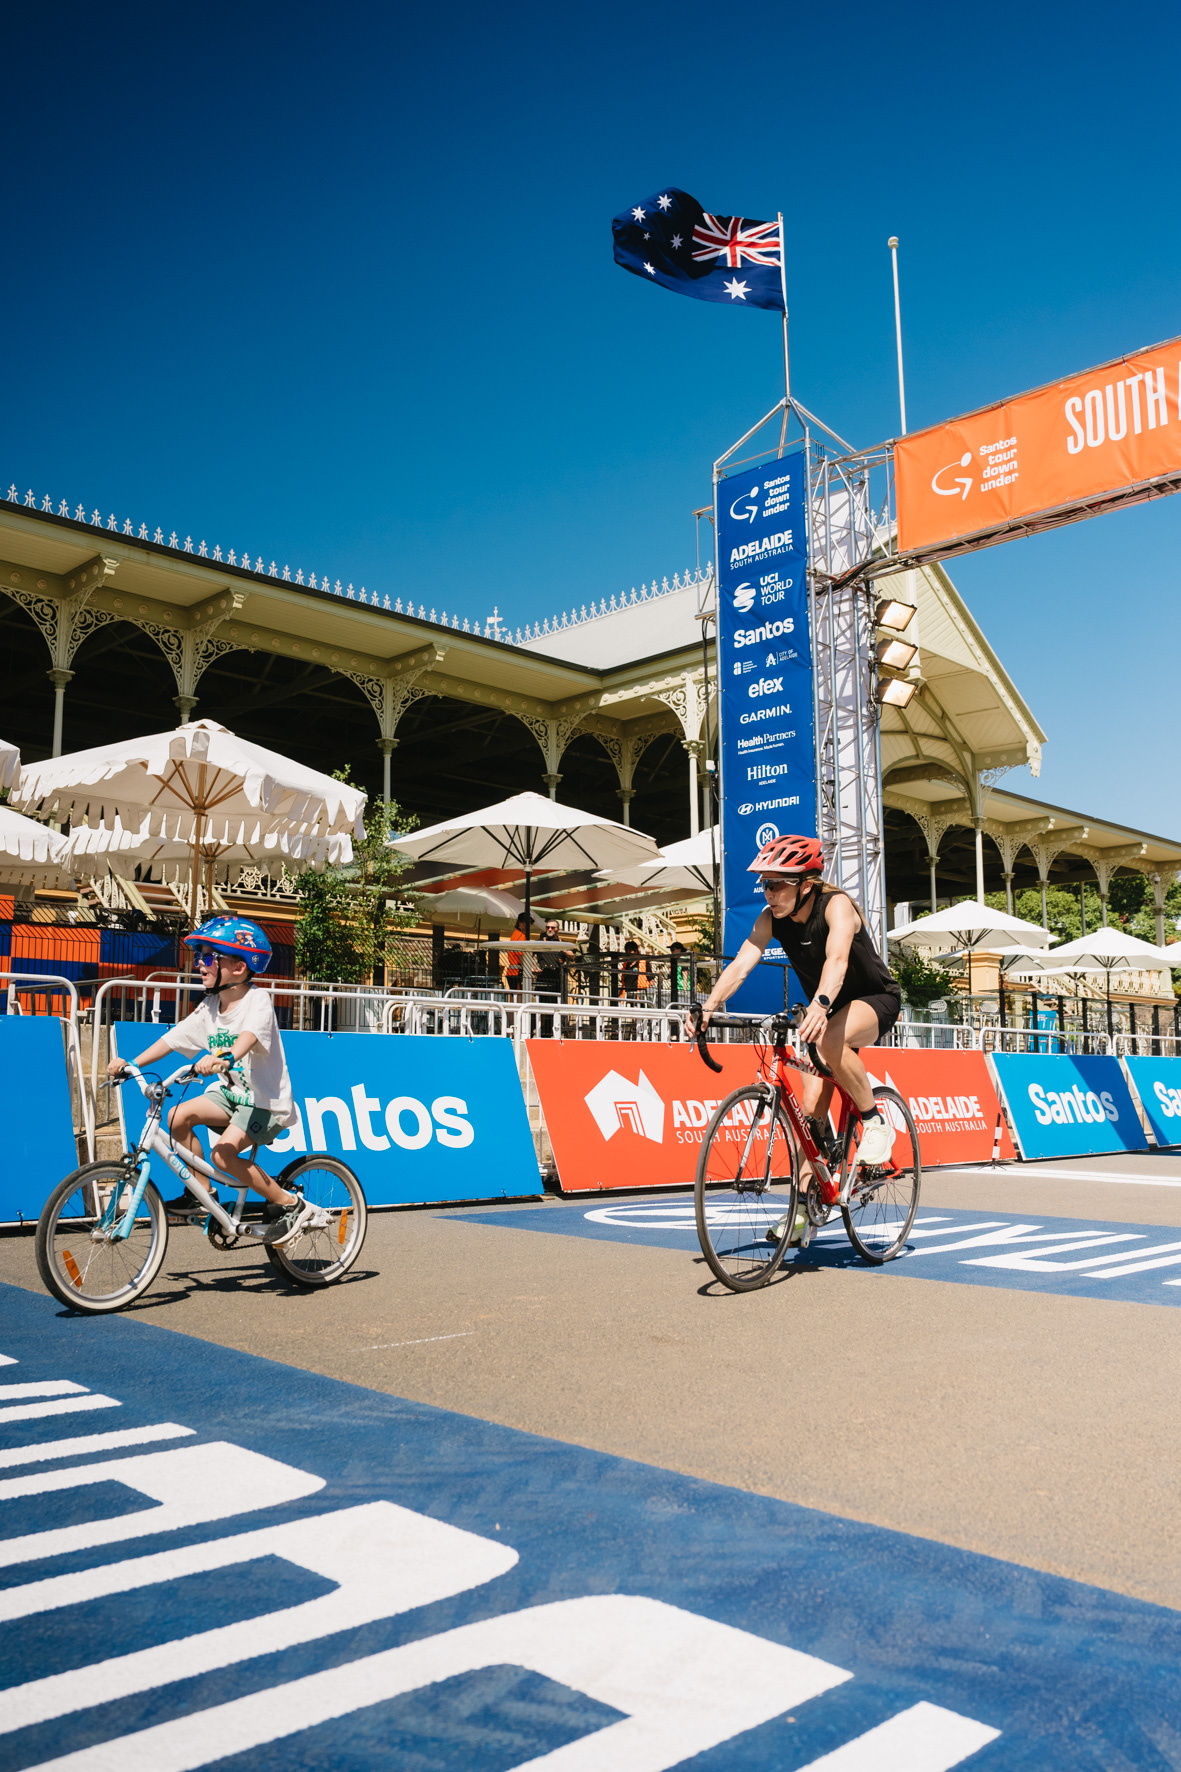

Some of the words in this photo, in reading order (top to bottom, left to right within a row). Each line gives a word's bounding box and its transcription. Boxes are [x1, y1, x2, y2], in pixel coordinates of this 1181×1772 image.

[1064, 366, 1168, 455] SOUTH
[979, 436, 1017, 456] Santos
[987, 447, 1017, 465] tour
[982, 459, 1018, 479] down
[763, 474, 790, 490] Santos
[769, 483, 790, 497] tour
[980, 472, 1019, 492] under
[763, 502, 790, 518] under
[765, 492, 790, 508] down
[730, 529, 793, 563] ADELAIDE
[730, 556, 753, 570] SOUTH
[754, 544, 794, 562] AUSTRALIA
[759, 572, 779, 586] UCI
[760, 577, 793, 597] WORLD
[761, 592, 785, 606] TOUR
[733, 617, 795, 649] Santos
[748, 676, 784, 698] efex
[740, 703, 790, 724] GARMIN
[747, 763, 788, 781] Hilton
[755, 795, 800, 812] HYUNDAI
[908, 1096, 984, 1121] ADELAIDE
[1027, 1083, 1119, 1126] Santos
[944, 1119, 988, 1132] AUSTRALIA
